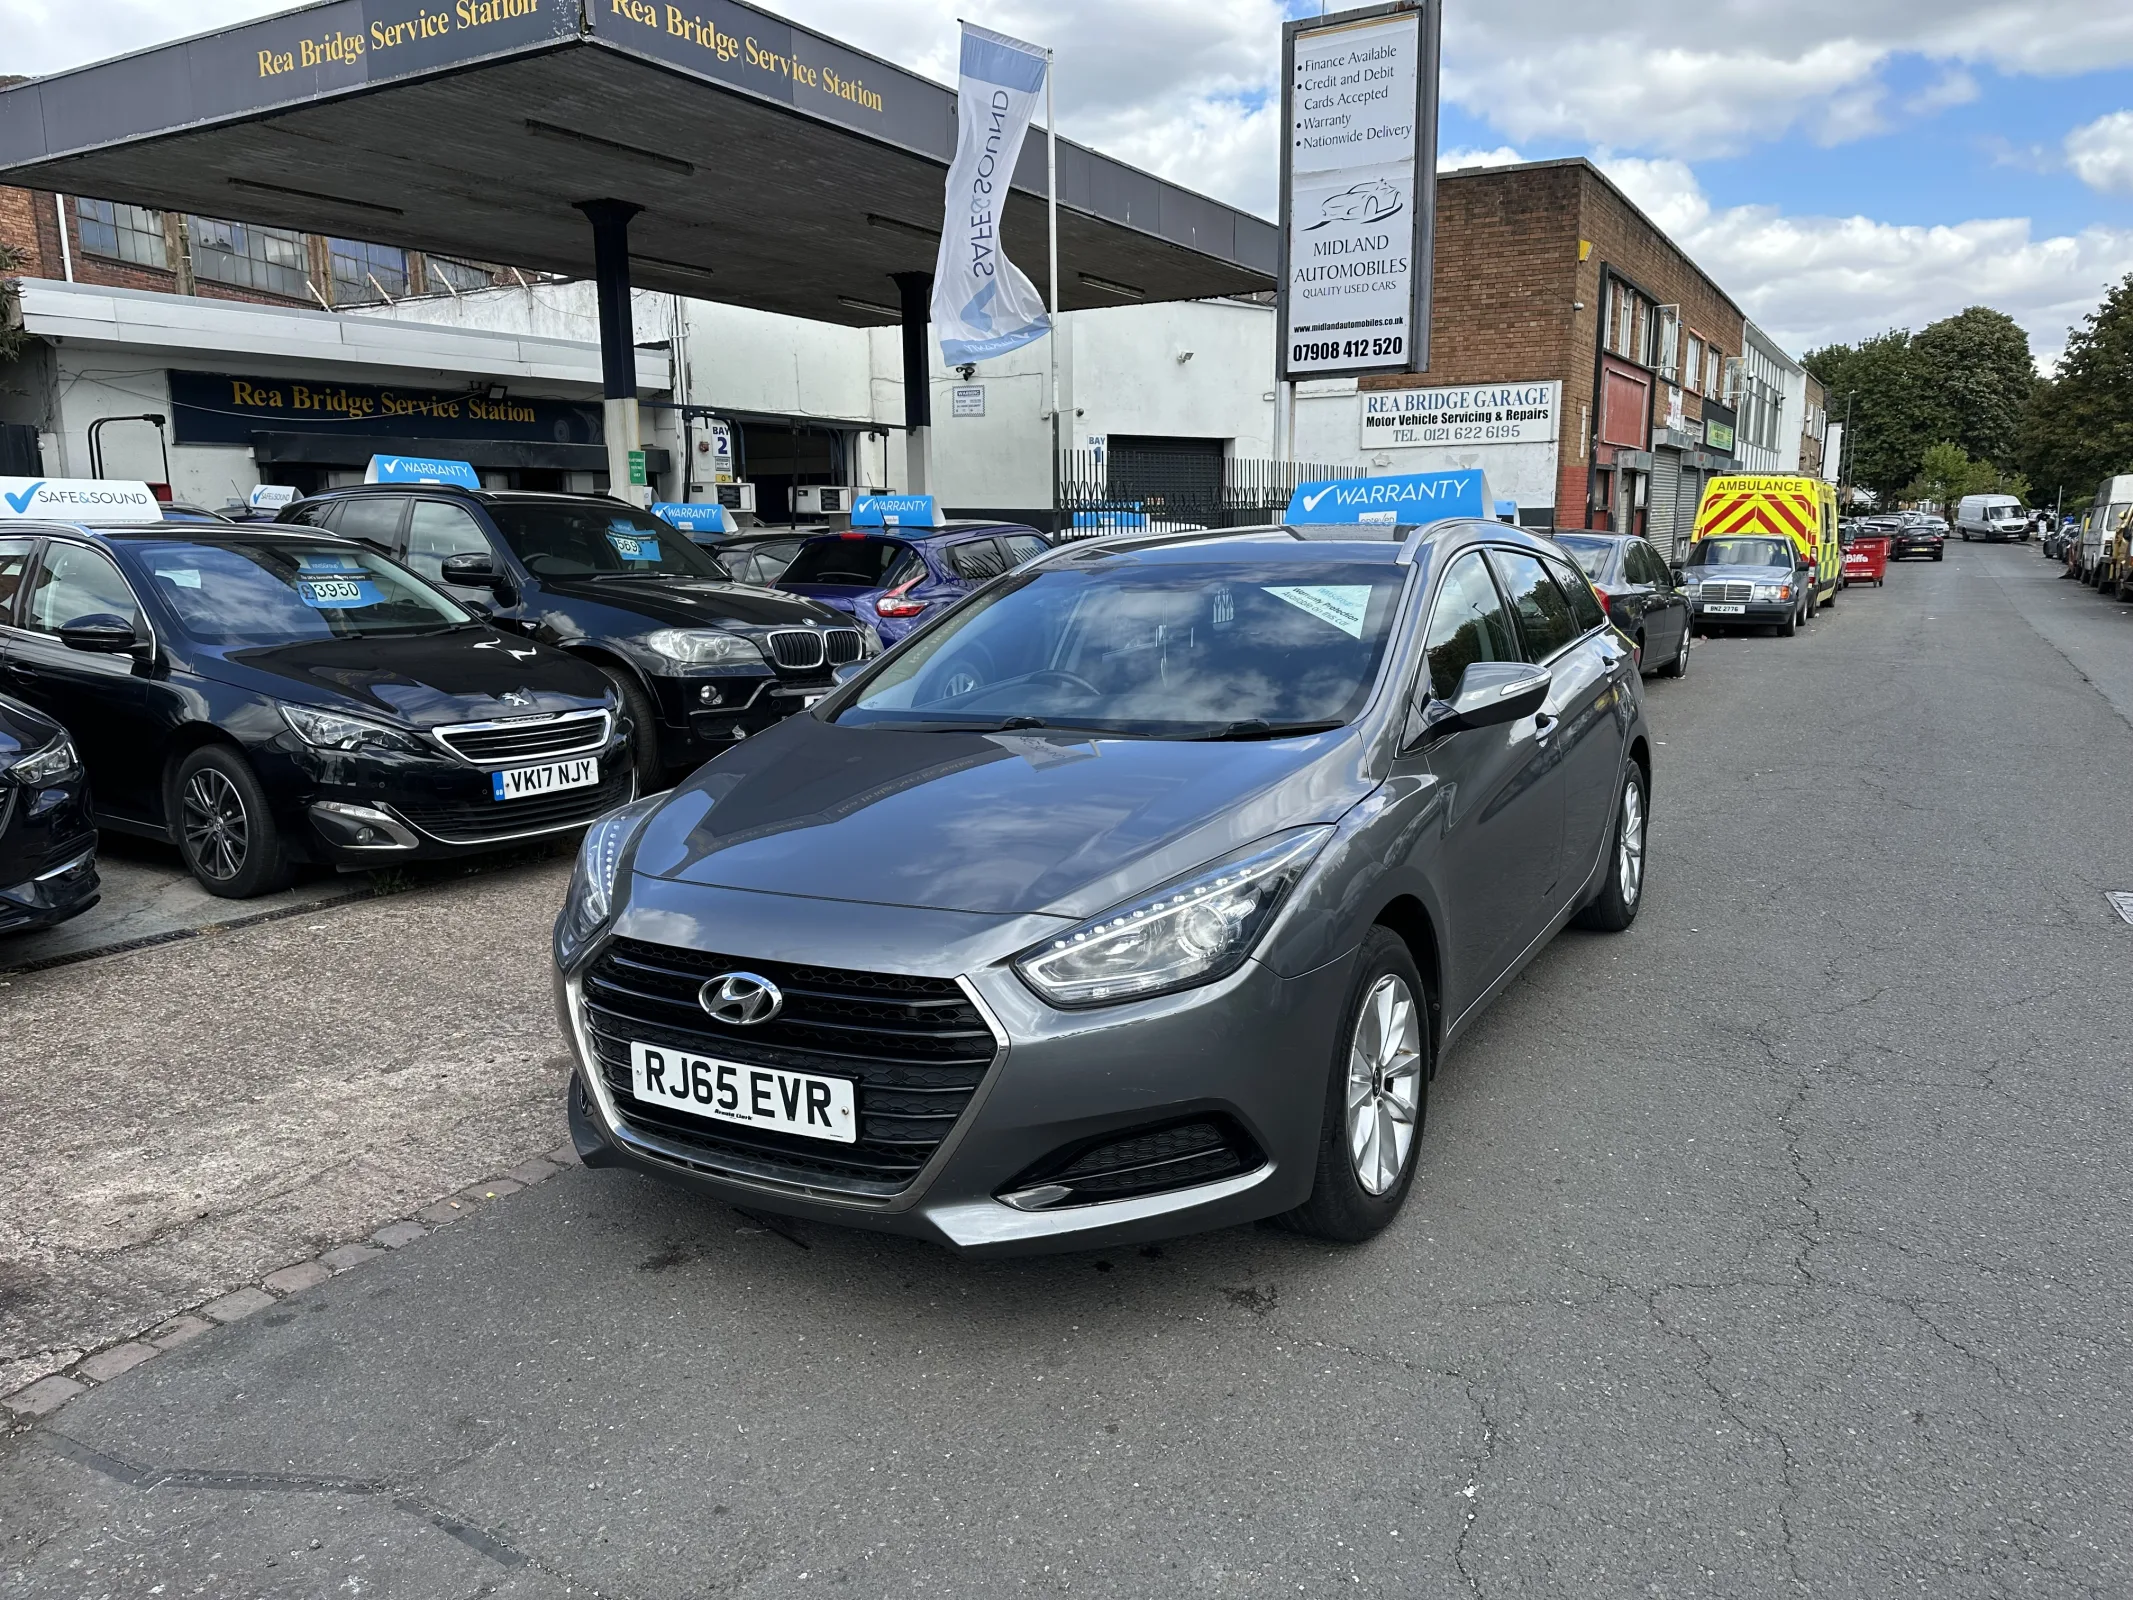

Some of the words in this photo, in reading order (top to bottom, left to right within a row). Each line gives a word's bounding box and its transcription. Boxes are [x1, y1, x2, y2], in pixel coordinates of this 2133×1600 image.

[258, 50, 294, 77] Rea
[300, 31, 365, 68] Bridge
[370, 10, 449, 50] Service
[456, 0, 539, 30] Station
[611, 0, 658, 28] Rea
[665, 3, 739, 62] Bridge
[745, 37, 817, 87] Service
[822, 67, 883, 112] Station
[1305, 57, 1345, 72] Finance
[1348, 45, 1397, 64] Available
[1304, 75, 1337, 91] Credit
[1340, 70, 1360, 86] and
[1364, 66, 1395, 82] Debit
[1304, 95, 1334, 110] Cards
[1337, 85, 1389, 106] Accepted
[1303, 114, 1352, 130] Warranty
[1303, 129, 1363, 149] Nationwide
[1367, 125, 1413, 140] Delivery
[1313, 234, 1389, 257] MIDLAND
[1294, 257, 1408, 283] AUTOMOBILES
[1302, 286, 1342, 299] QUALITY
[1344, 282, 1370, 294] USED
[1372, 280, 1397, 291] CARS
[1293, 316, 1404, 333] www.midlandautomobiles.co.uk
[1293, 341, 1340, 362] 07908
[1343, 339, 1369, 358] 412
[1372, 336, 1403, 356] 520
[232, 380, 283, 408] Rea
[292, 386, 374, 418] Bridge
[381, 392, 460, 419] Service
[468, 398, 536, 423] Station
[1367, 395, 1400, 414] REA
[1404, 391, 1470, 412] BRIDGE
[1473, 387, 1549, 407] GARAGE
[1366, 414, 1396, 428] Motor
[1399, 411, 1438, 426] Vehicle
[1441, 410, 1492, 425] Servicing
[1495, 410, 1503, 422] &
[1506, 407, 1549, 422] Repairs
[712, 426, 730, 436] BAY
[1088, 436, 1105, 445] BAY
[1393, 429, 1420, 443] TEL.
[1423, 428, 1450, 441] 0121
[1454, 426, 1482, 440] 622
[1485, 424, 1521, 438] 6195
[717, 436, 728, 455] 2
[1093, 446, 1102, 464] 1
[400, 460, 469, 478] WARRANTY
[1336, 478, 1470, 505] WARRANTY
[1717, 481, 1803, 492] AMBULANCE
[38, 490, 148, 506] SAFE&SOUND
[872, 500, 928, 512] WARRANTY
[667, 507, 718, 519] WARRANTY
[1846, 553, 1869, 564] Biffa
[1323, 601, 1359, 622] Protection
[510, 766, 553, 793] VK17
[558, 760, 590, 784] NJY
[645, 1049, 739, 1110] RJ65
[750, 1070, 832, 1127] EVR
